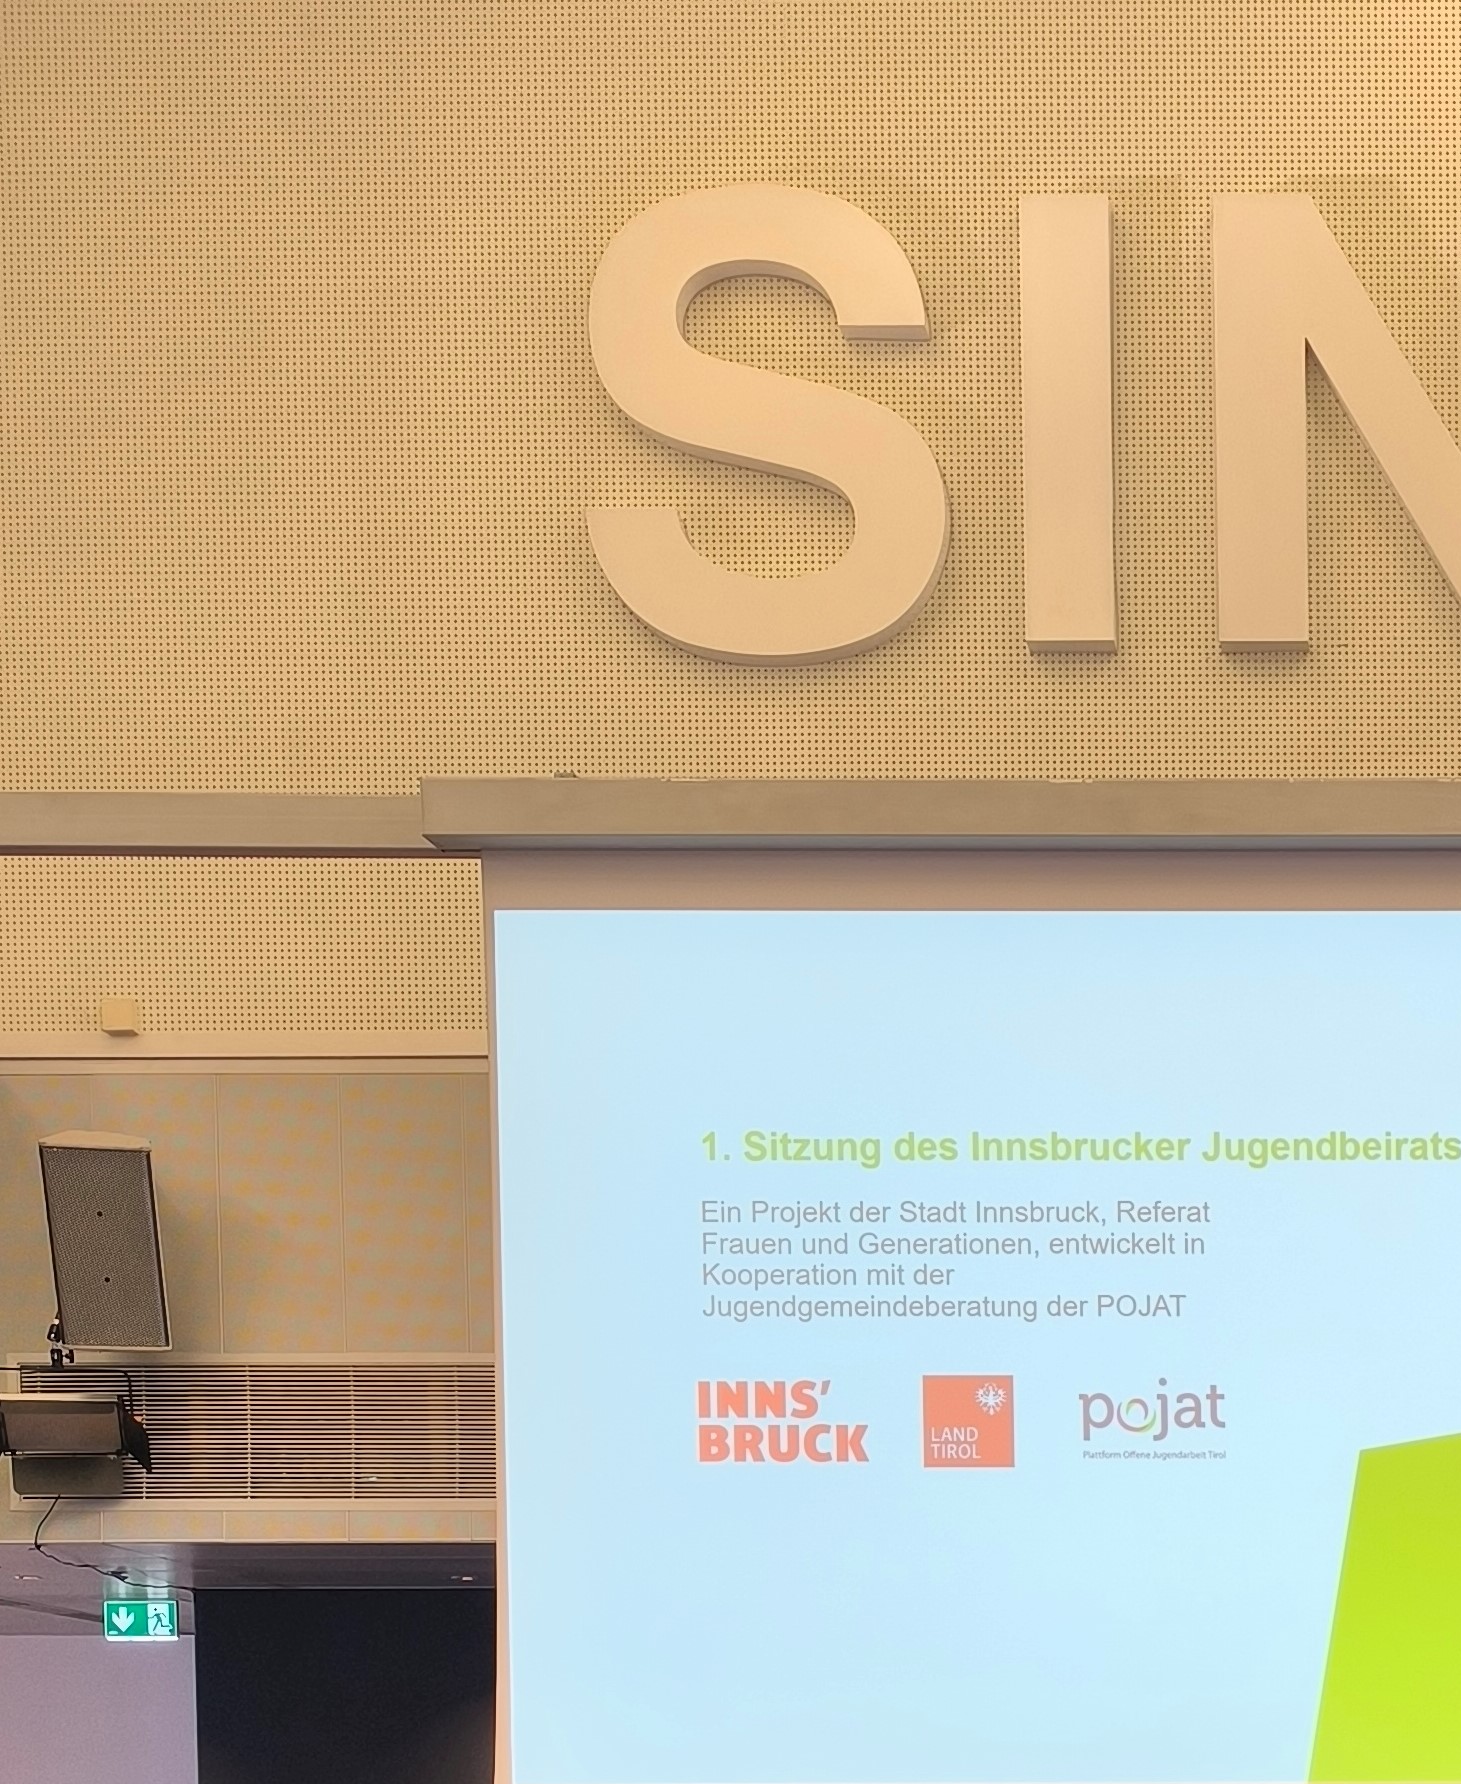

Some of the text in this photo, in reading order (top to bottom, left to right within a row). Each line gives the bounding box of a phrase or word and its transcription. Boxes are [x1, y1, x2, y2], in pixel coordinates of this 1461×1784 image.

[702, 1131, 731, 1162] 1.
[743, 1130, 881, 1170] Sitzung
[894, 1131, 959, 1162] des
[972, 1131, 1192, 1162] Innsbrucker
[701, 1200, 1211, 1229] Ein Projekt der Stadt Innsbruck, Referat
[702, 1231, 1205, 1260] Frauen und Generationen, entwickelt in
[702, 1262, 956, 1292] Kooperation mit der
[702, 1294, 1187, 1323] Jugendgemeindeberatung der POJAT
[1078, 1376, 1226, 1442] pojat
[697, 1422, 870, 1463] BRUCK
[930, 1426, 979, 1442] LAND
[930, 1443, 982, 1459] TIROL
[1082, 1449, 1227, 1462] Plattform Offene Jugendarbeit Tirol
